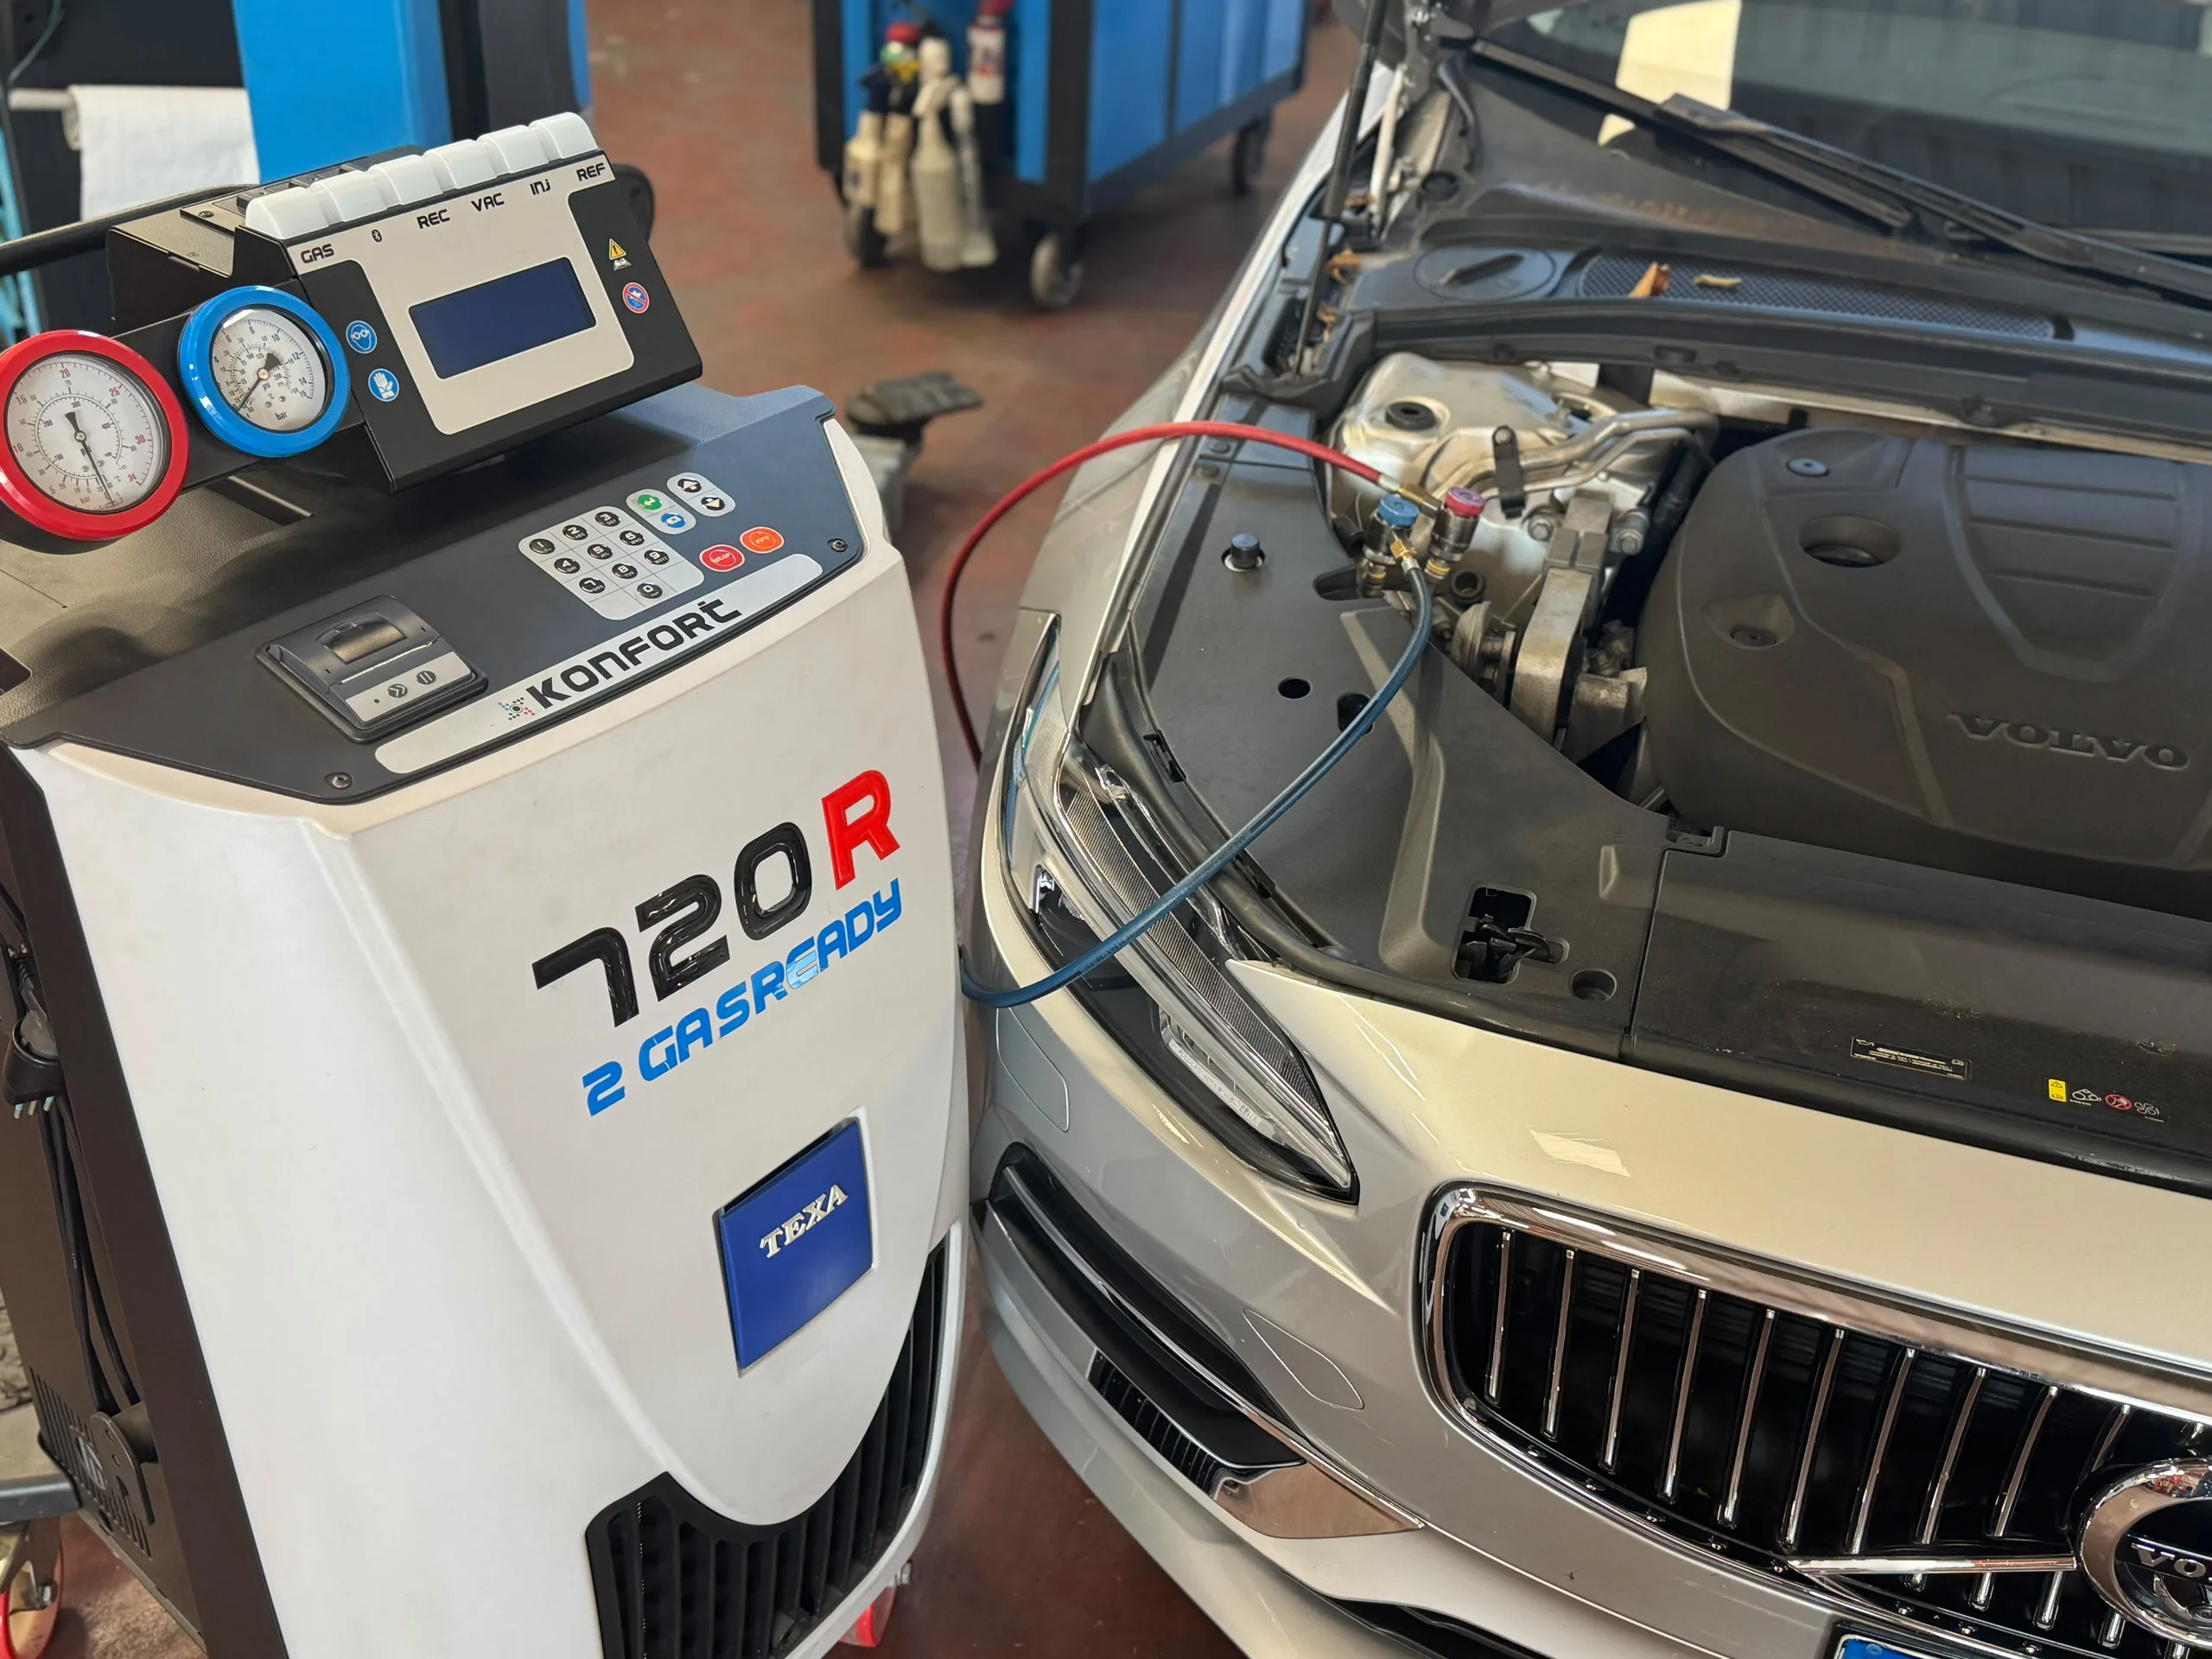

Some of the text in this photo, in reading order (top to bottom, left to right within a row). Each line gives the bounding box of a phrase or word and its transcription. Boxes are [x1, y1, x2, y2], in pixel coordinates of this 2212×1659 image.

[576, 162, 606, 181] REF
[470, 192, 505, 213] VAC
[416, 208, 451, 230] REC
[300, 243, 335, 264] GAS
[249, 326, 256, 334] 8
[271, 334, 281, 342] 10
[292, 352, 301, 361] 12
[60, 368, 71, 379] 20
[298, 377, 308, 385] 14
[109, 386, 121, 397] 25
[262, 383, 271, 392] psi
[299, 390, 308, 398] 15
[16, 395, 28, 405] 15
[275, 411, 288, 421] bar
[43, 420, 54, 429] 200
[135, 435, 146, 445] 30
[12, 442, 24, 454] 10
[80, 445, 92, 456] pi
[127, 473, 137, 482] 34
[49, 486, 56, 494] 5
[567, 526, 581, 535] 2
[649, 551, 661, 560] 9
[525, 598, 742, 709] KONFORT
[1947, 712, 2190, 771] VOLVO
[582, 1061, 626, 1117] 2
[760, 1185, 849, 1258] TEXA
[2131, 1542, 2212, 1582] VO
